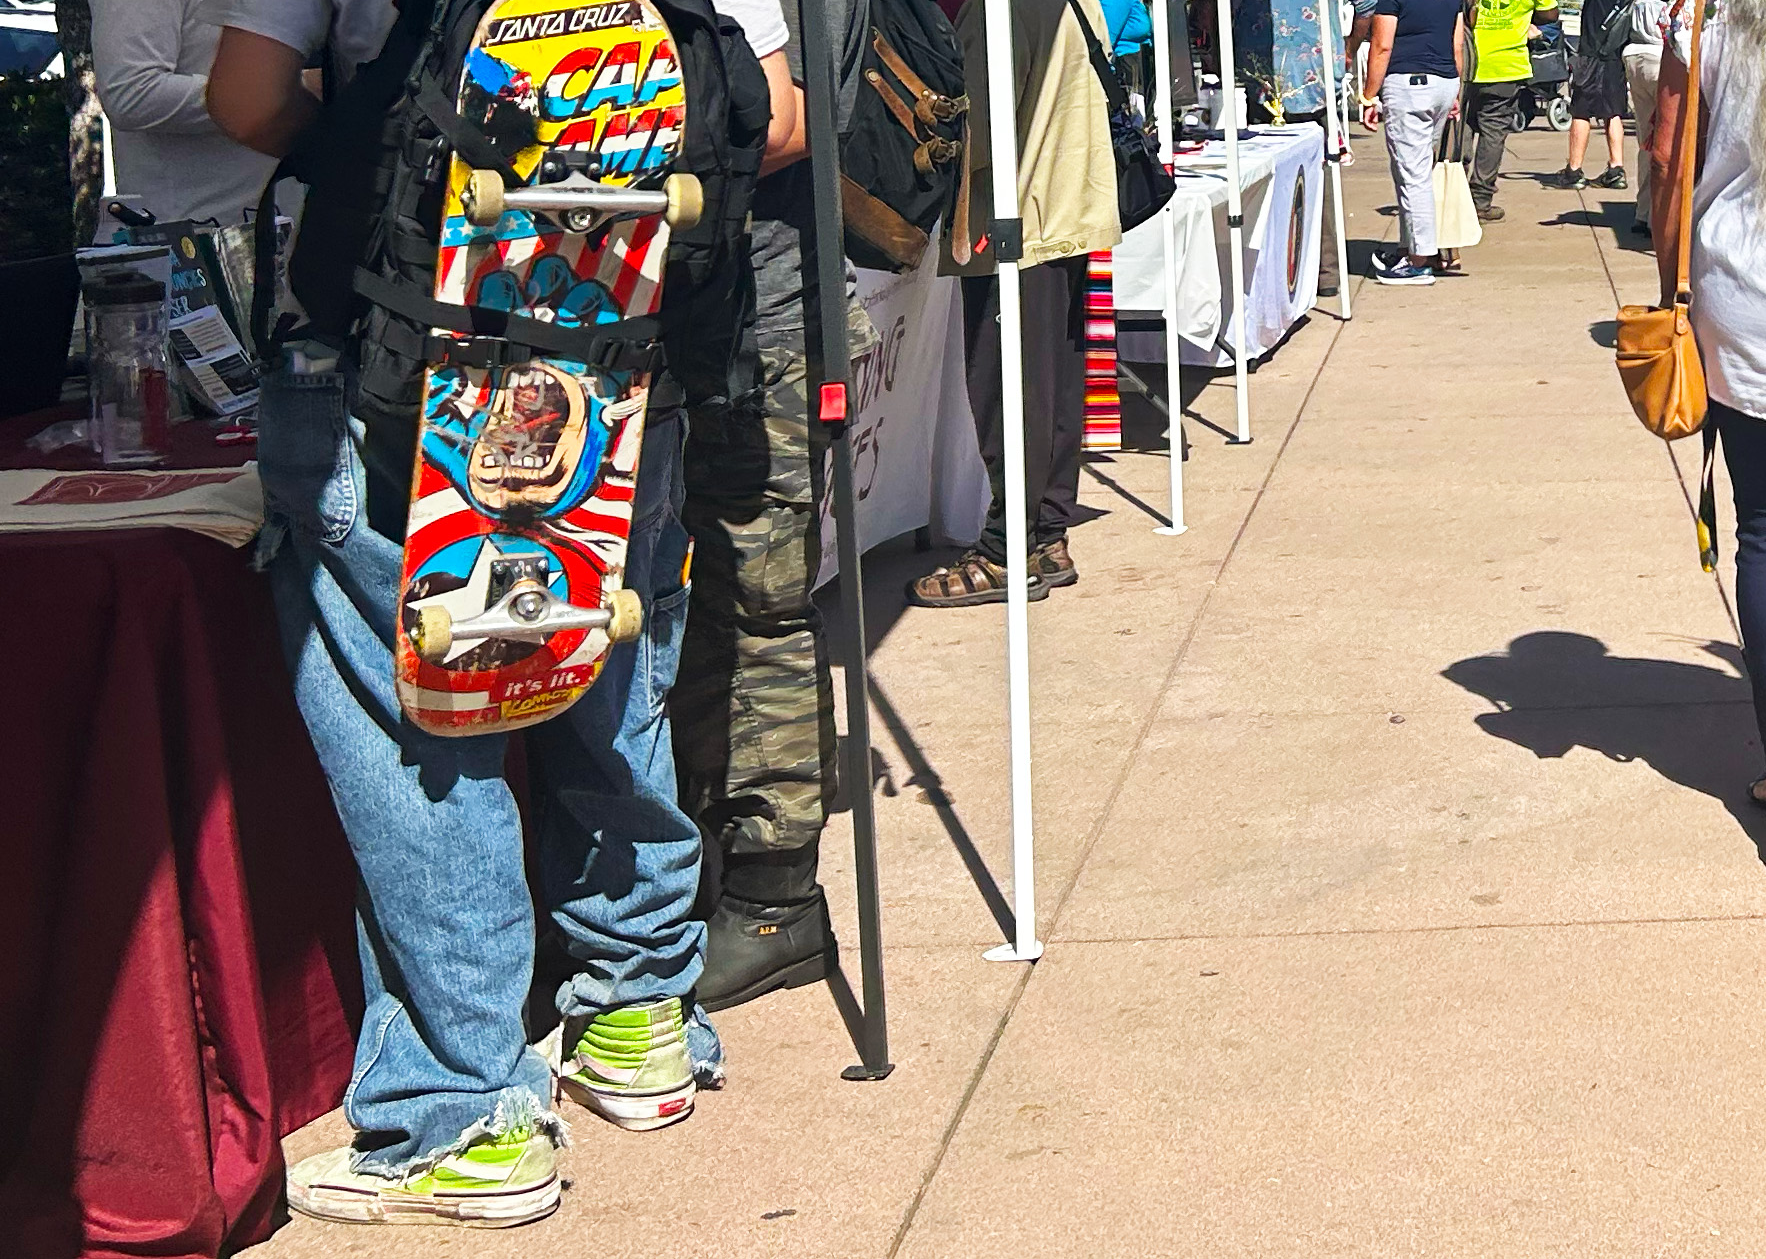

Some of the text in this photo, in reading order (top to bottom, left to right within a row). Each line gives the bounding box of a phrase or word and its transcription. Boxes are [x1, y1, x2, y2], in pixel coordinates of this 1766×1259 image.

[486, 2, 631, 45] SANTA CRUZ
[504, 671, 581, 698] it's lit.
